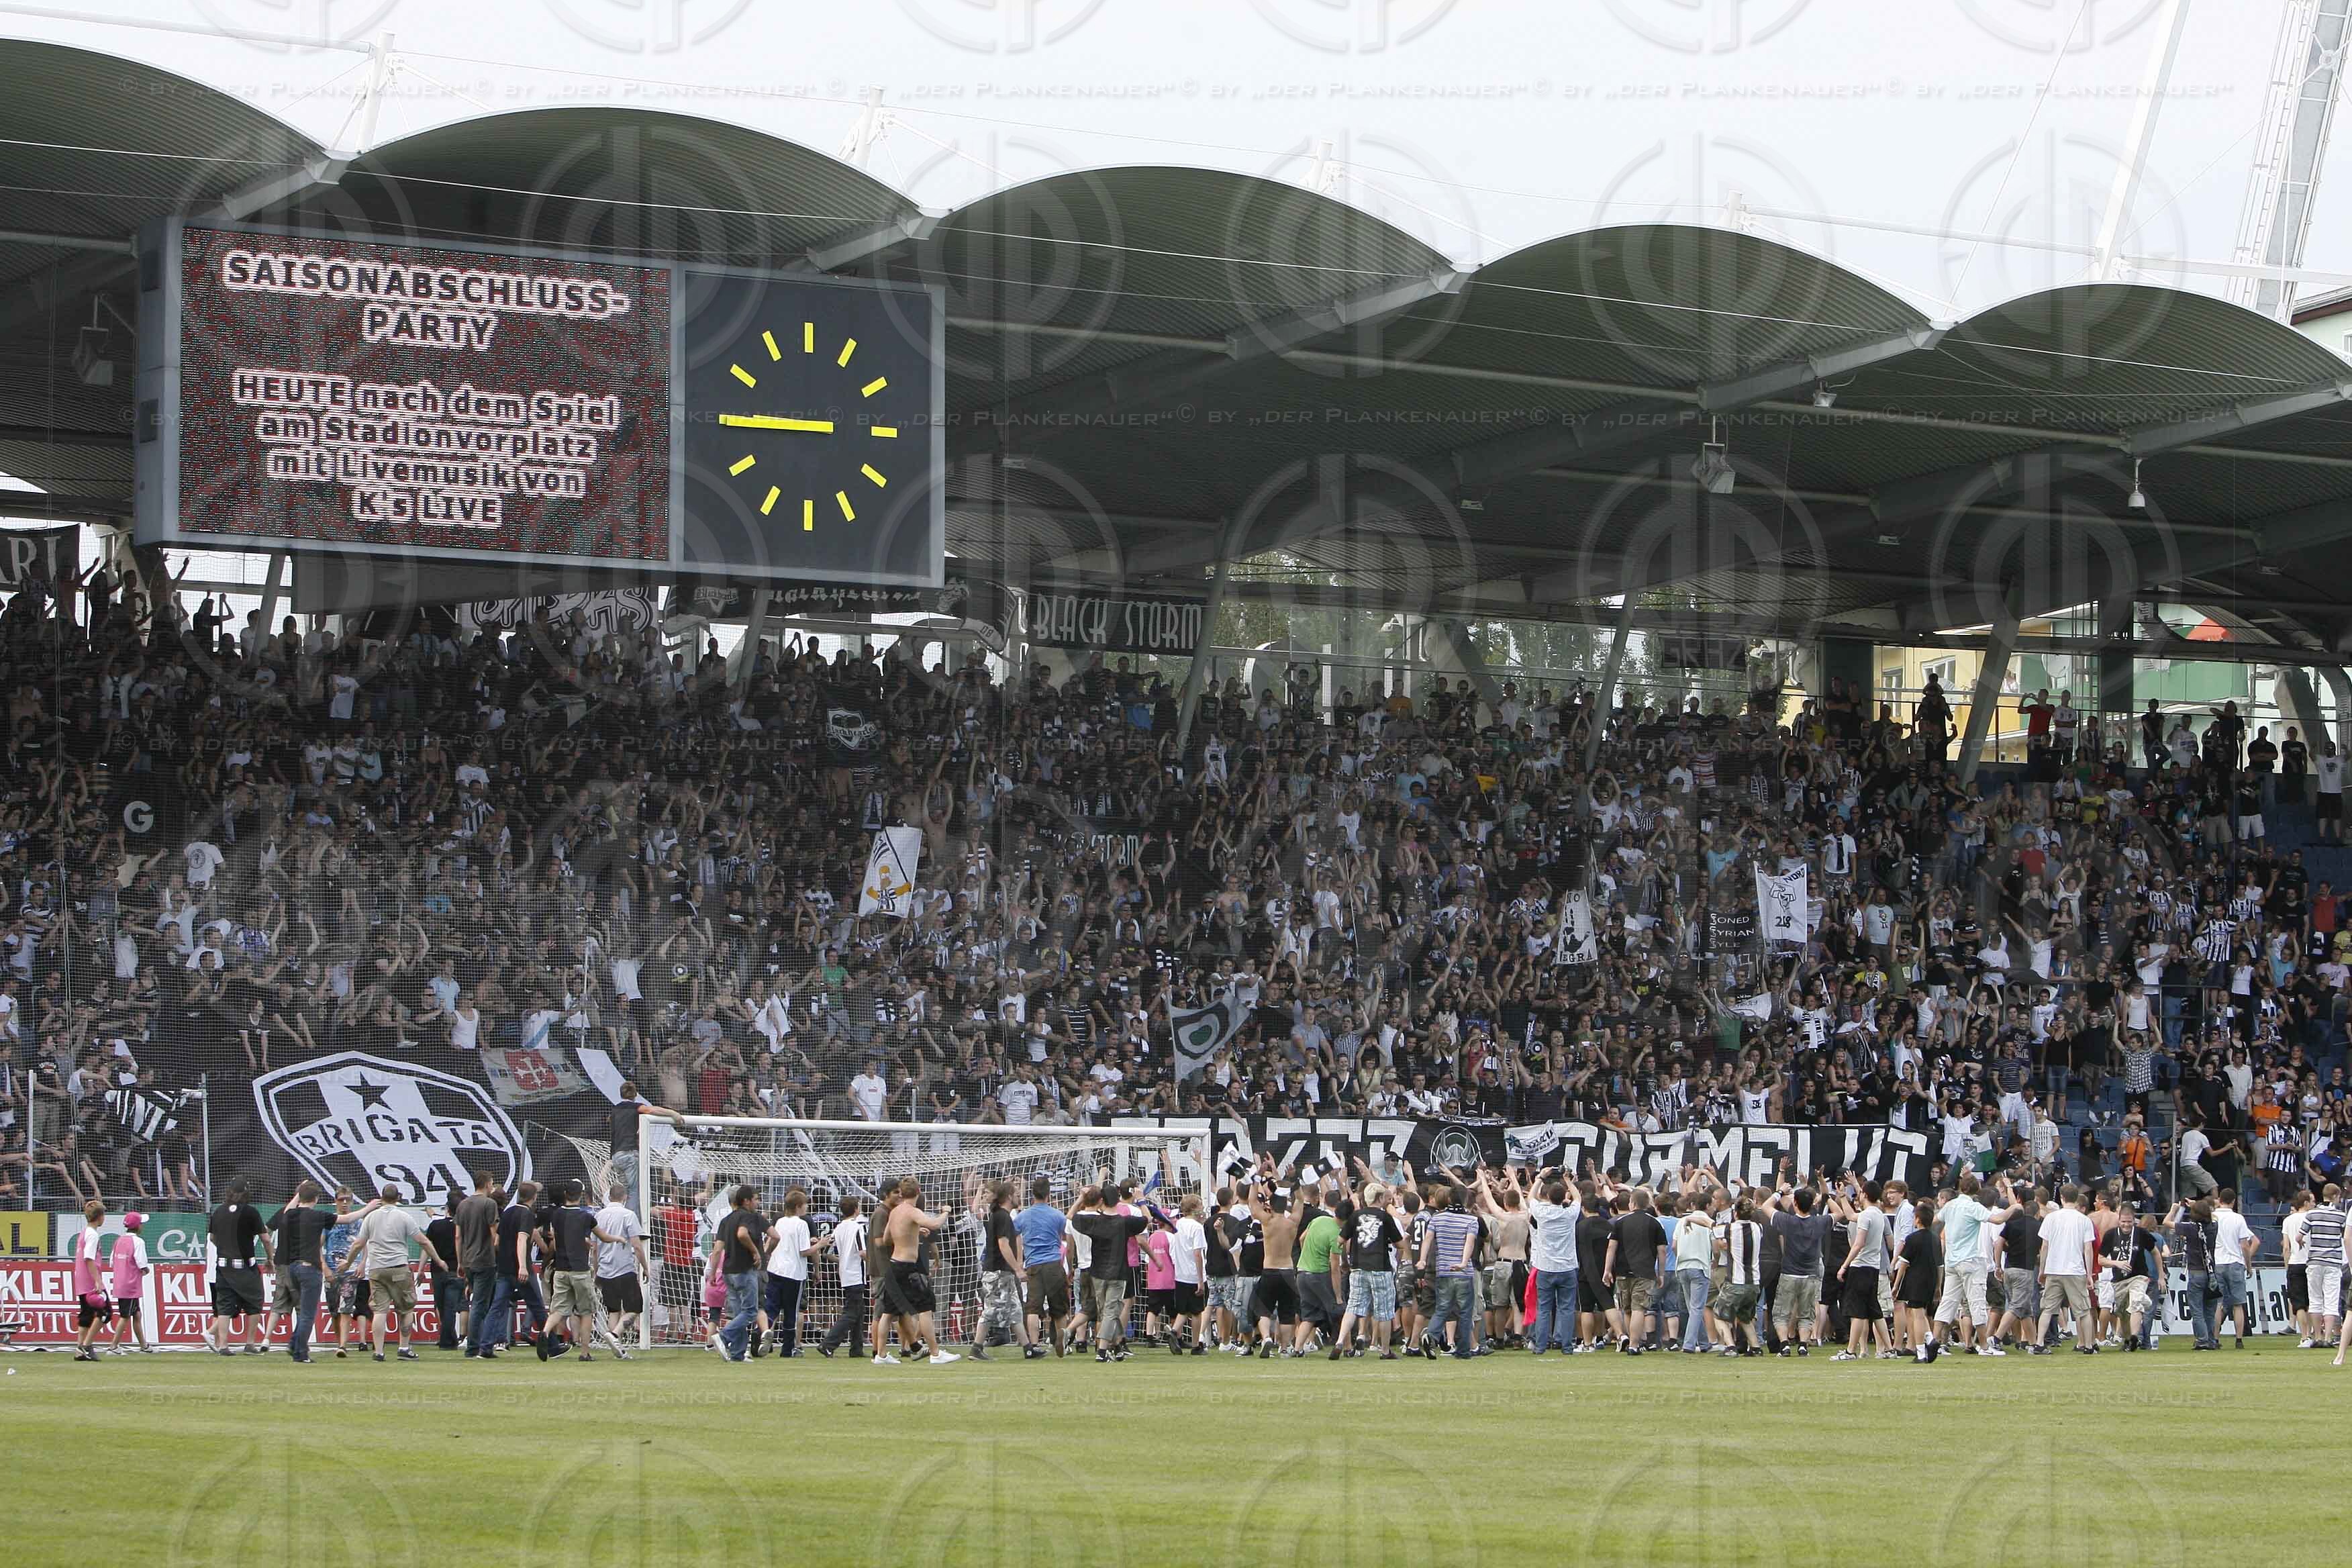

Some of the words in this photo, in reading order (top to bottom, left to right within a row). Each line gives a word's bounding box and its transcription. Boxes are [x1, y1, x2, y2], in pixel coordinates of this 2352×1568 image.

[226, 251, 626, 315] SAISONABSCHLUSS-
[366, 307, 494, 347] PARTY
[237, 373, 350, 407] HEUTE
[360, 385, 442, 414] nach
[452, 387, 524, 420] dem
[535, 395, 616, 426] Spiel
[262, 415, 312, 438] am
[324, 416, 593, 461] Stadionvorplatz
[272, 451, 330, 476] mit
[341, 454, 517, 489] Livemusik
[523, 469, 583, 495] von
[357, 491, 411, 518] K's
[421, 492, 499, 522] LIVE
[1033, 594, 1108, 644] BLACK
[124, 801, 154, 832] G
[296, 1114, 503, 1154] BRIGATA
